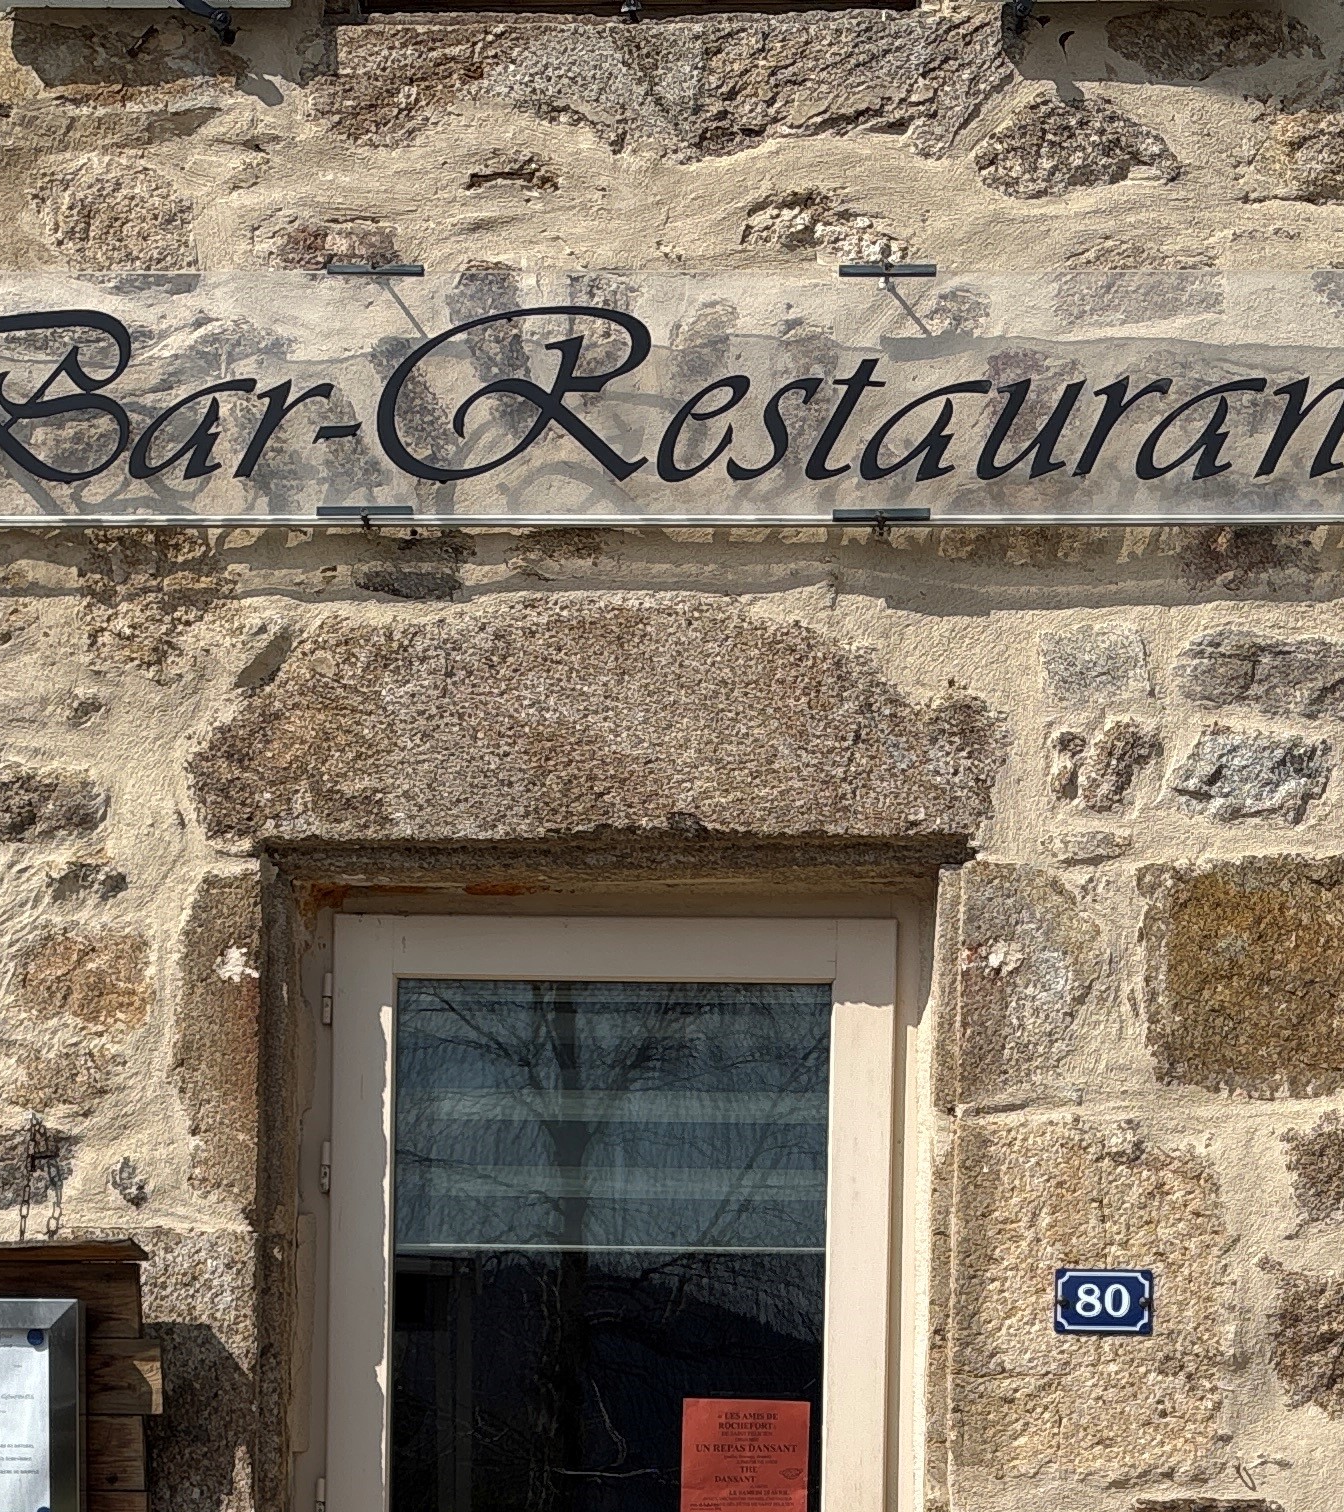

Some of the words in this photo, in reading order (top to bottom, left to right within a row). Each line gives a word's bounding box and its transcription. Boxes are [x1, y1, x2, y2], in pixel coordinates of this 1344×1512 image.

[1076, 1283, 1131, 1318] 80
[724, 1412, 741, 1420] LES
[742, 1412, 765, 1420] AMIS
[766, 1412, 779, 1420] DE
[696, 1443, 712, 1453] UN
[713, 1443, 746, 1453] REPAS
[748, 1443, 797, 1453] DANSANT
